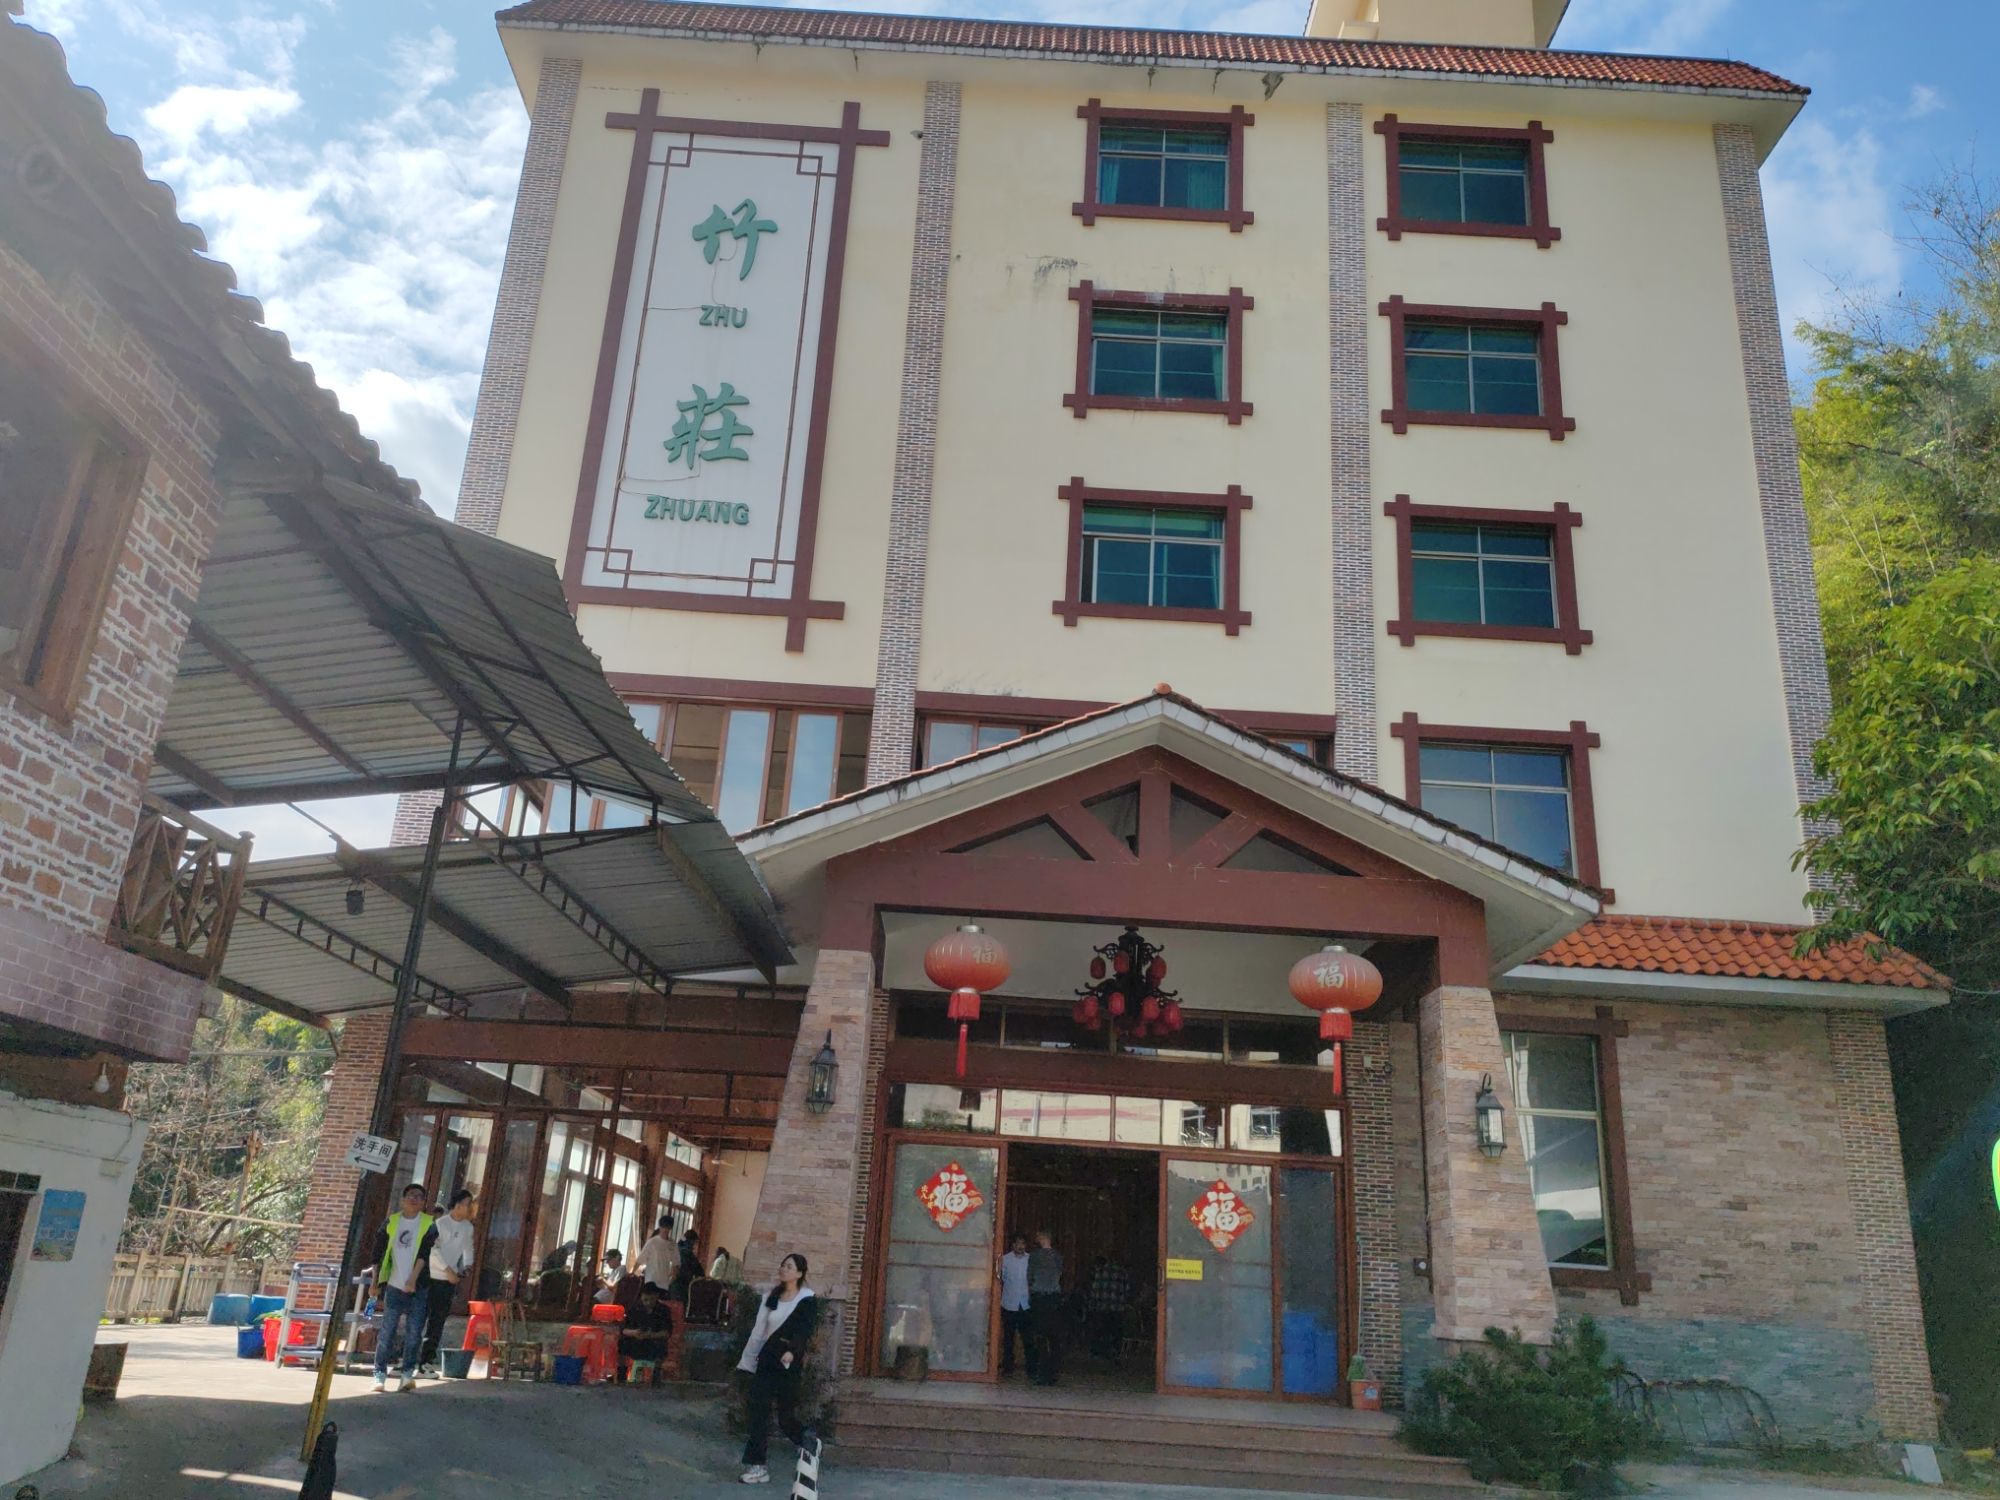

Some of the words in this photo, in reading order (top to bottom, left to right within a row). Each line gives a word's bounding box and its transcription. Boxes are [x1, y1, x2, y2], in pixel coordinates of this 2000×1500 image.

[692, 198, 778, 281] 竹
[699, 305, 747, 328] ZHU
[663, 382, 754, 469] 莊
[644, 495, 750, 526] ZHUANG
[971, 945, 998, 966] 福
[1313, 960, 1345, 989] 福
[353, 1136, 392, 1157] 洗手间
[935, 1172, 969, 1213] 福
[1203, 1191, 1240, 1231] 福
